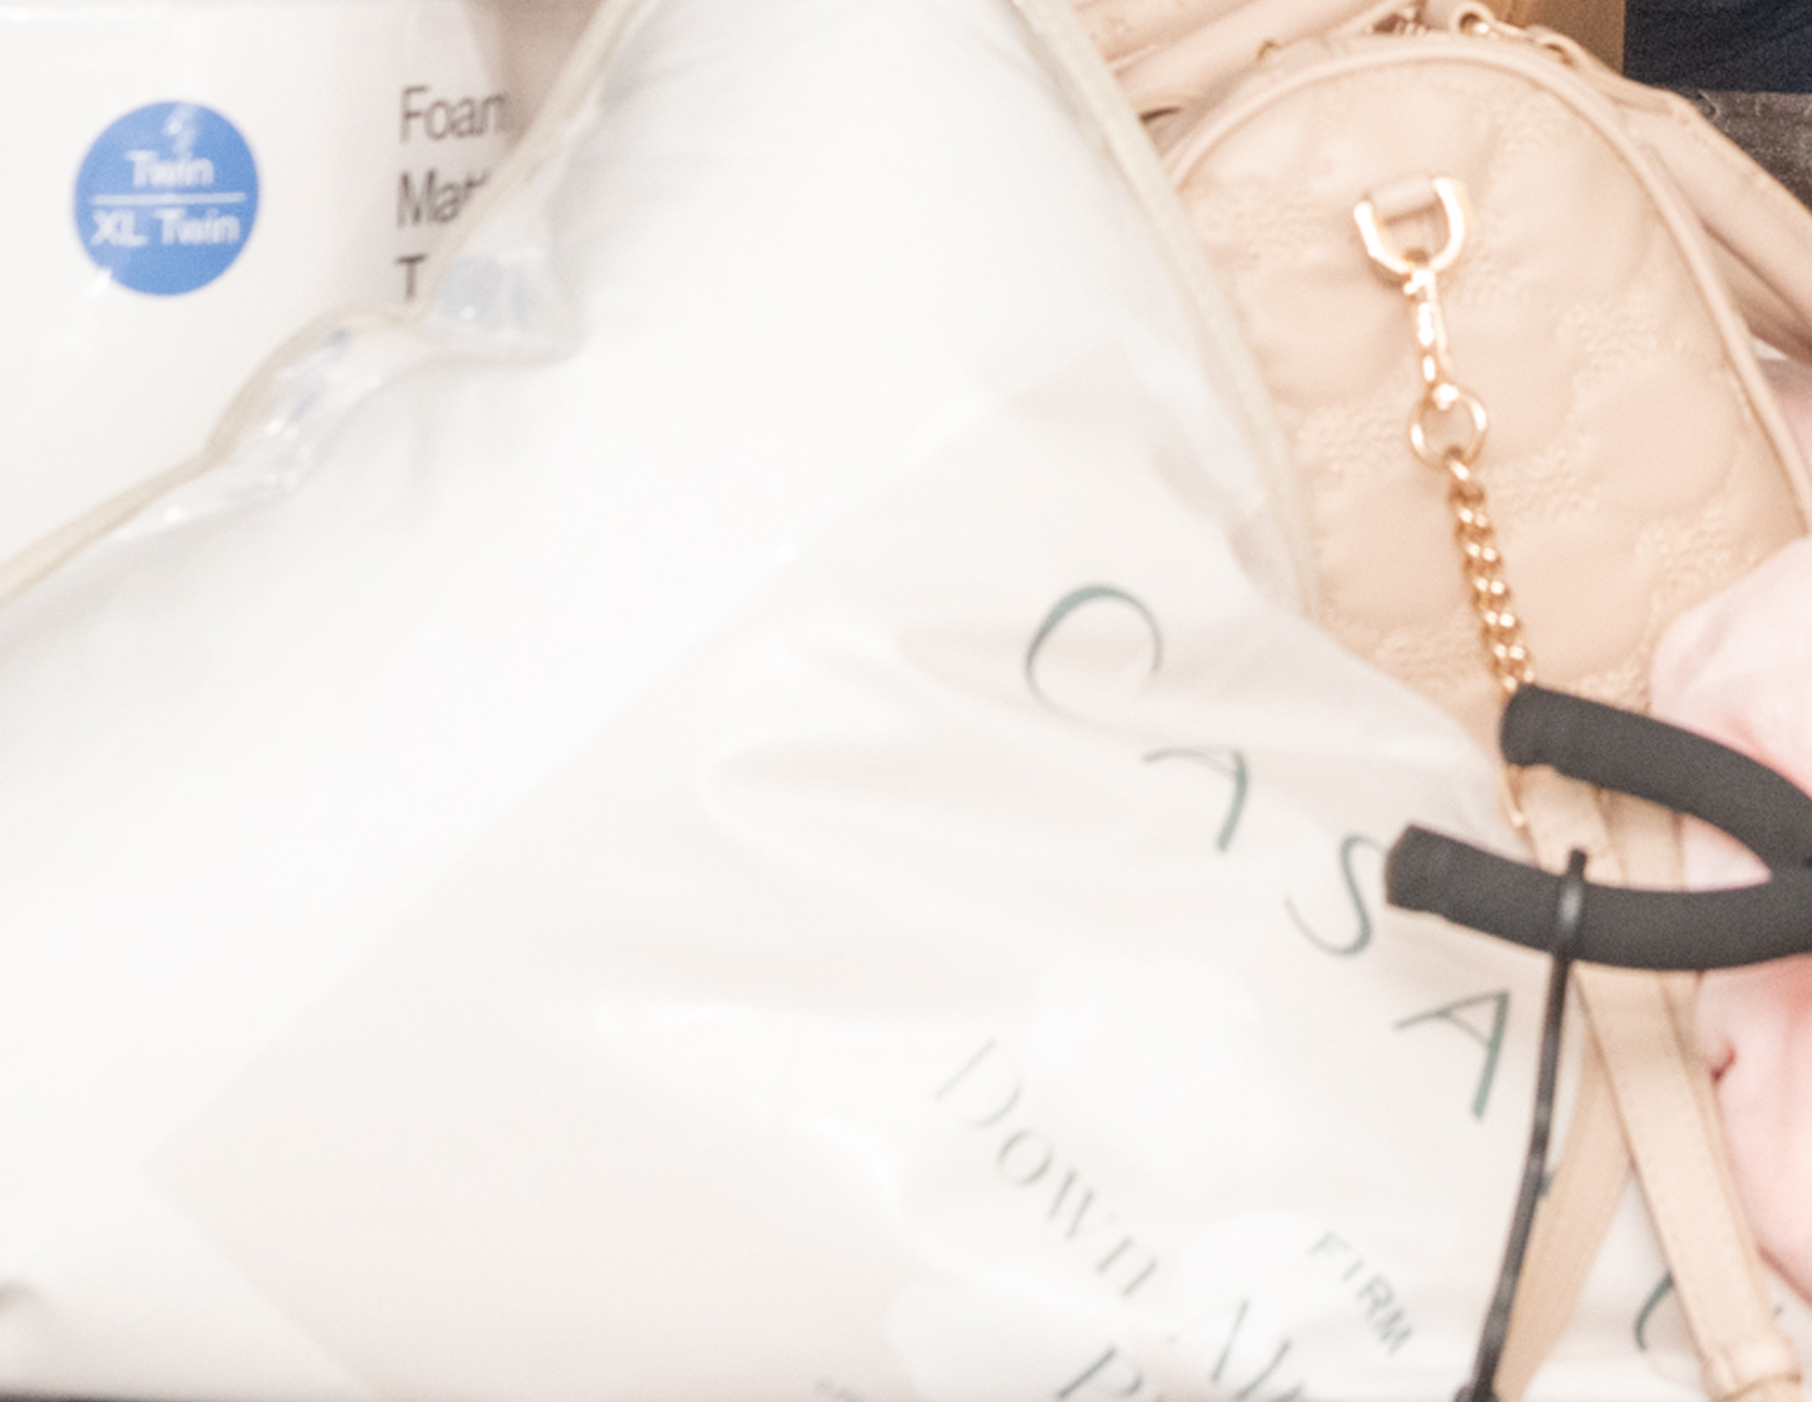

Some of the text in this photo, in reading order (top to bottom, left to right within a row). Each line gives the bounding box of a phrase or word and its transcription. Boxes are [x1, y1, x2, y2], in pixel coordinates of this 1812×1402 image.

[124, 150, 215, 188] Twin
[90, 208, 241, 246] XL Twin
[1023, 585, 1510, 1120] CASA
[1308, 1231, 1413, 1354] FIRM
